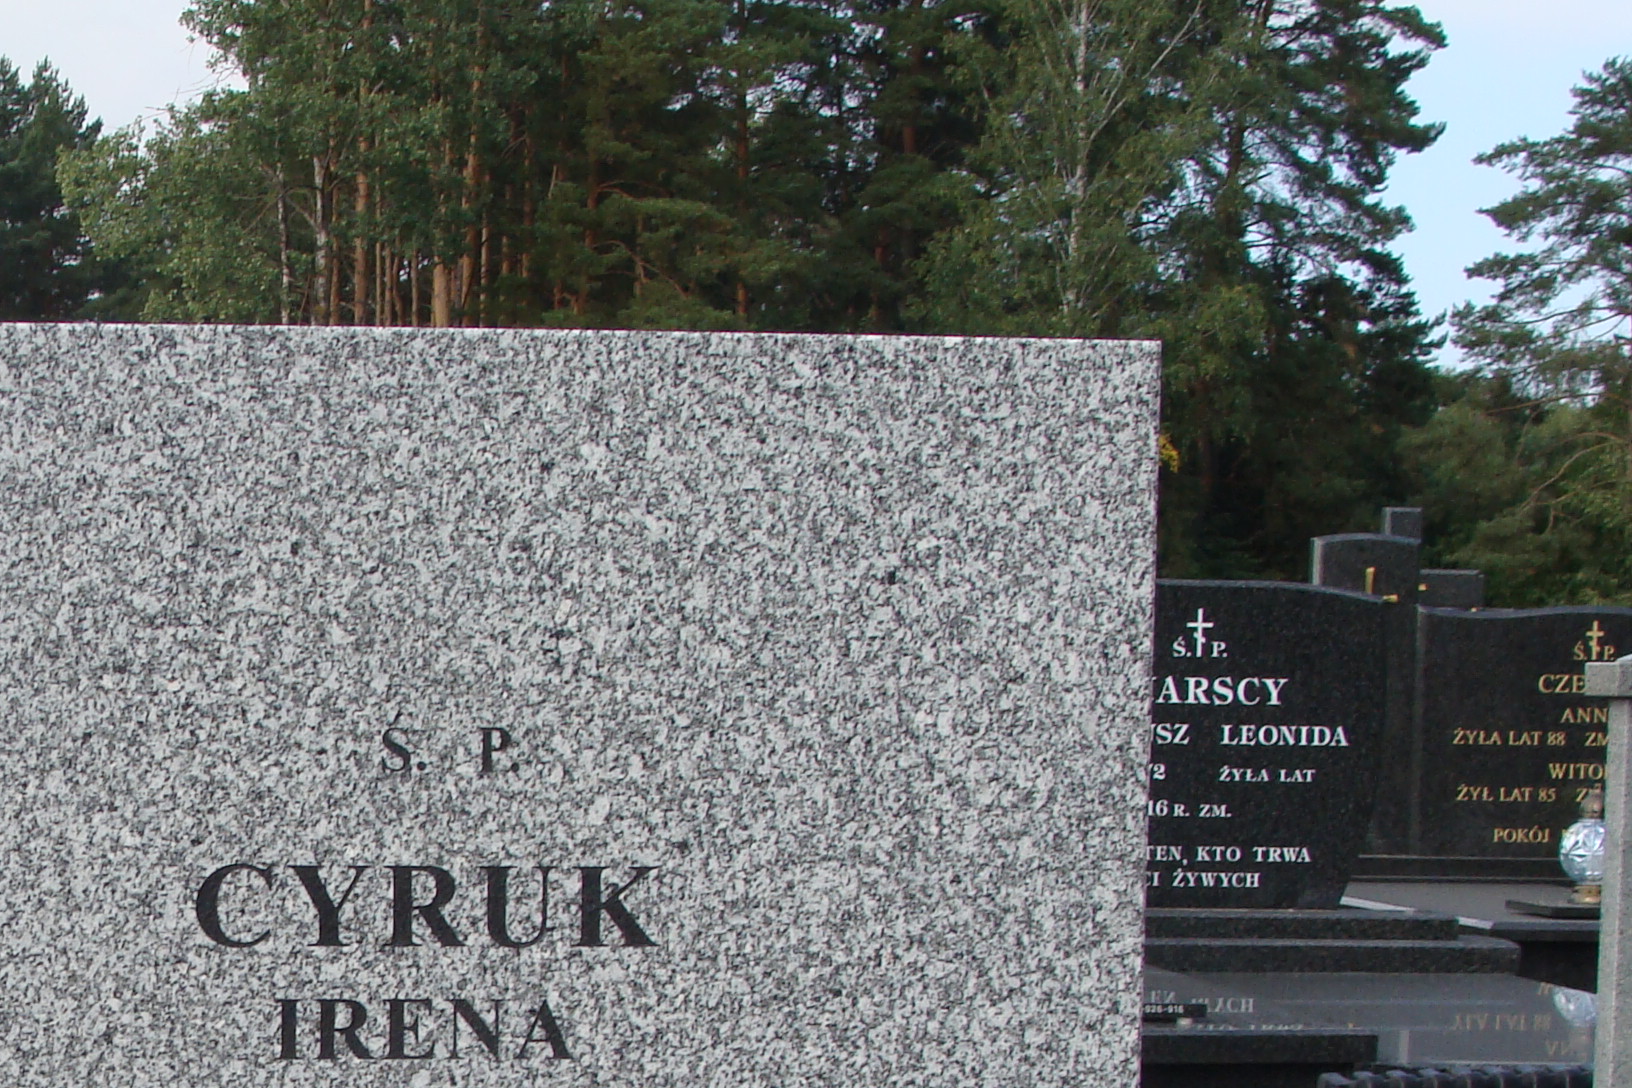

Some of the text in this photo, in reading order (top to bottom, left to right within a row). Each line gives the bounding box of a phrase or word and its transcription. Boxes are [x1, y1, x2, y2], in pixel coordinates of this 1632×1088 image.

[1210, 641, 1228, 657] P.
[1152, 675, 1288, 706] ARSCY
[1151, 723, 1349, 747] SZ LEONIDA
[1452, 727, 1503, 745] ŻYŁA
[1509, 731, 1543, 746] LAT
[1547, 730, 1566, 746] 88
[479, 726, 520, 773] P.
[1219, 765, 1268, 782] ŻYŁA
[1279, 769, 1316, 783] LAT
[1456, 784, 1494, 801] ŻYŁ
[1499, 787, 1534, 802] LAT
[1538, 787, 1556, 802] 85
[1173, 803, 1190, 817] R.
[1199, 804, 1232, 818] ZM.
[1493, 825, 1551, 843] POKÓJ
[1196, 846, 1241, 861] KTO
[1253, 846, 1311, 863] TRWA
[1172, 868, 1261, 888] ŻYWYCH
[195, 863, 661, 948] CYRUK
[275, 998, 571, 1060] IRENA
